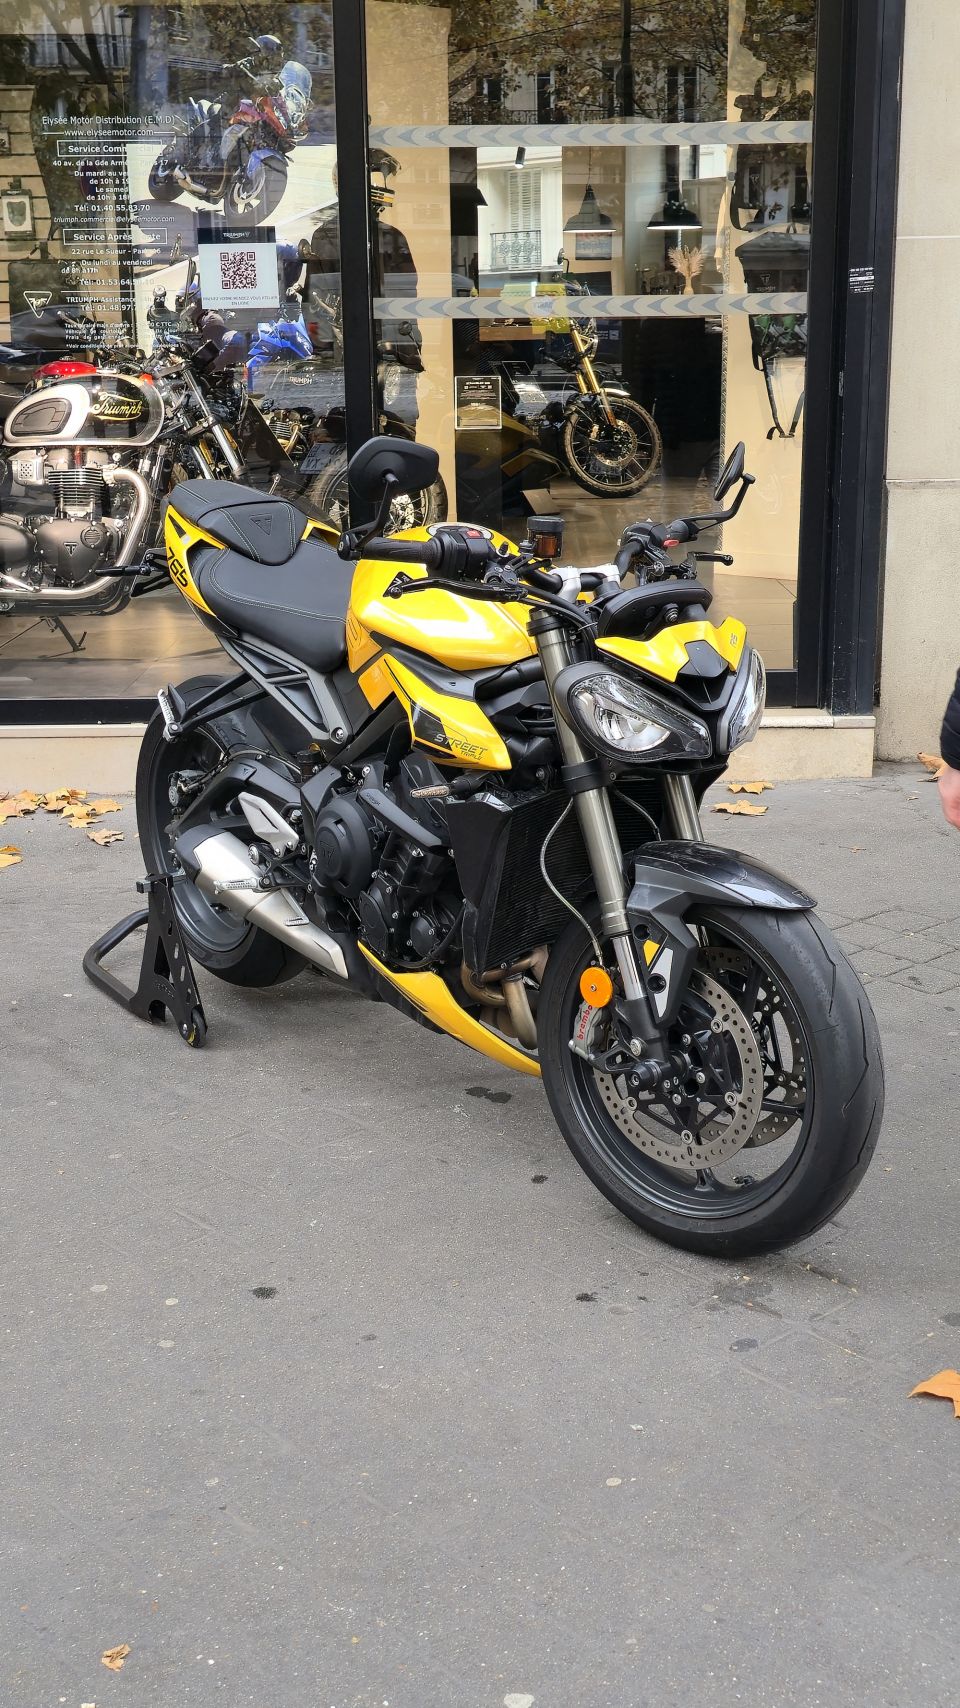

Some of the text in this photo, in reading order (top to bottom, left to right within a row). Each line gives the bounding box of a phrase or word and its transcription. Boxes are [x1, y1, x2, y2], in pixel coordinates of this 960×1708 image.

[70, 116, 93, 125] Motor
[95, 115, 142, 124] Distribution
[64, 129, 154, 137] www.elyseemotor.com
[68, 145, 100, 153] Service
[89, 177, 99, 185] de
[100, 177, 114, 185] 10h
[73, 233, 106, 241] Service
[122, 258, 153, 266] vendredi
[91, 391, 143, 418] Triumph
[168, 546, 188, 587] 765
[434, 733, 488, 756] STREET
[576, 1004, 593, 1040] brembo
